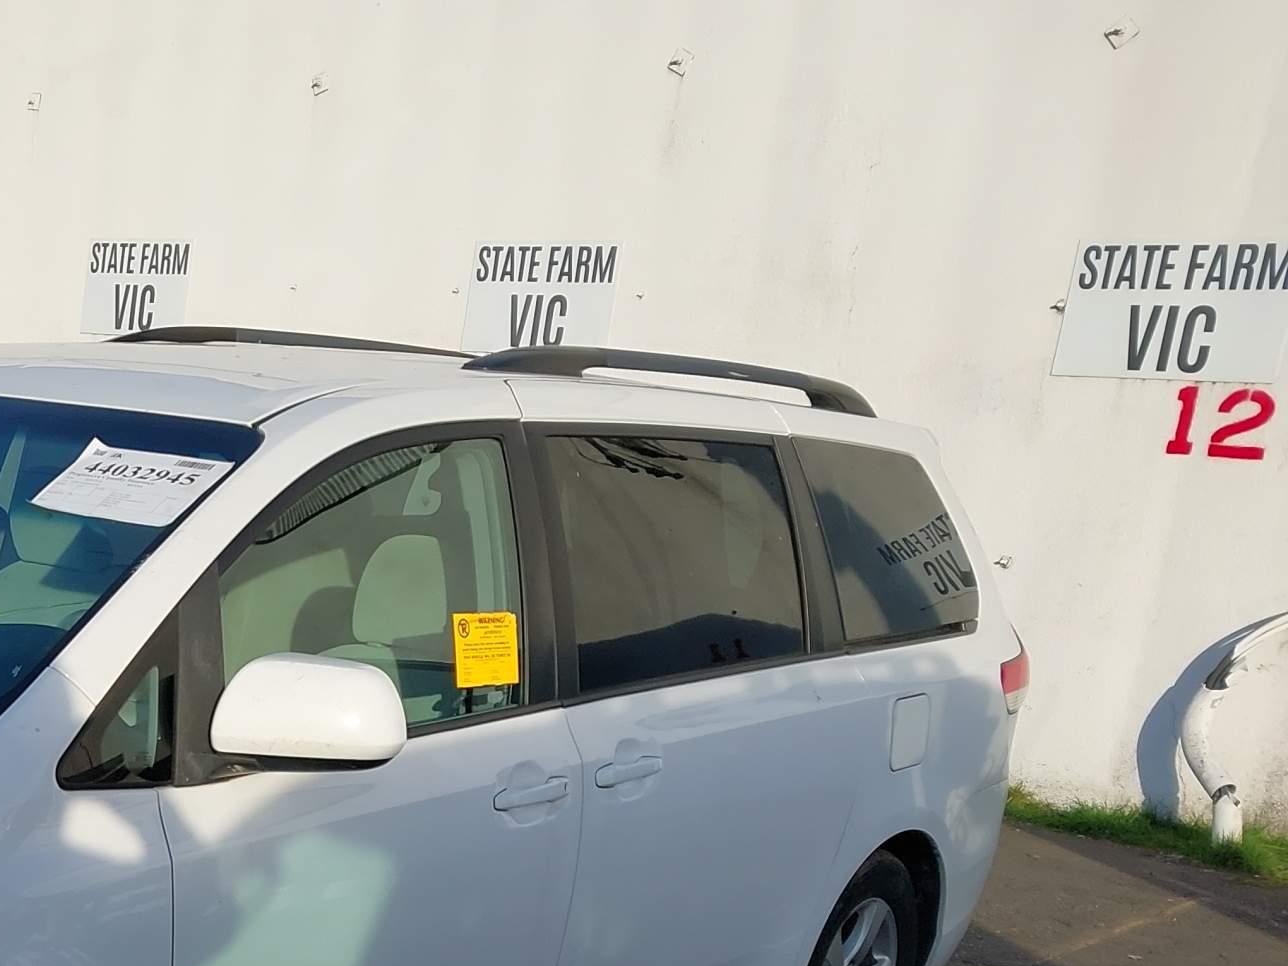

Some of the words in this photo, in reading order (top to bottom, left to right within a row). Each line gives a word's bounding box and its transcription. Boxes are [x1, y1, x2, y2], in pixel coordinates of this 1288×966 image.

[90, 242, 137, 274] STATE
[139, 243, 190, 275] FARM
[476, 246, 543, 282] STATE
[546, 246, 617, 283] FARM
[1078, 244, 1180, 290] STATE
[1184, 243, 1288, 290] FARM
[114, 284, 156, 331] VIC
[510, 294, 568, 347] VIC
[1127, 305, 1217, 373] VIC
[1165, 385, 1276, 460] 12
[85, 462, 201, 485] 44032945
